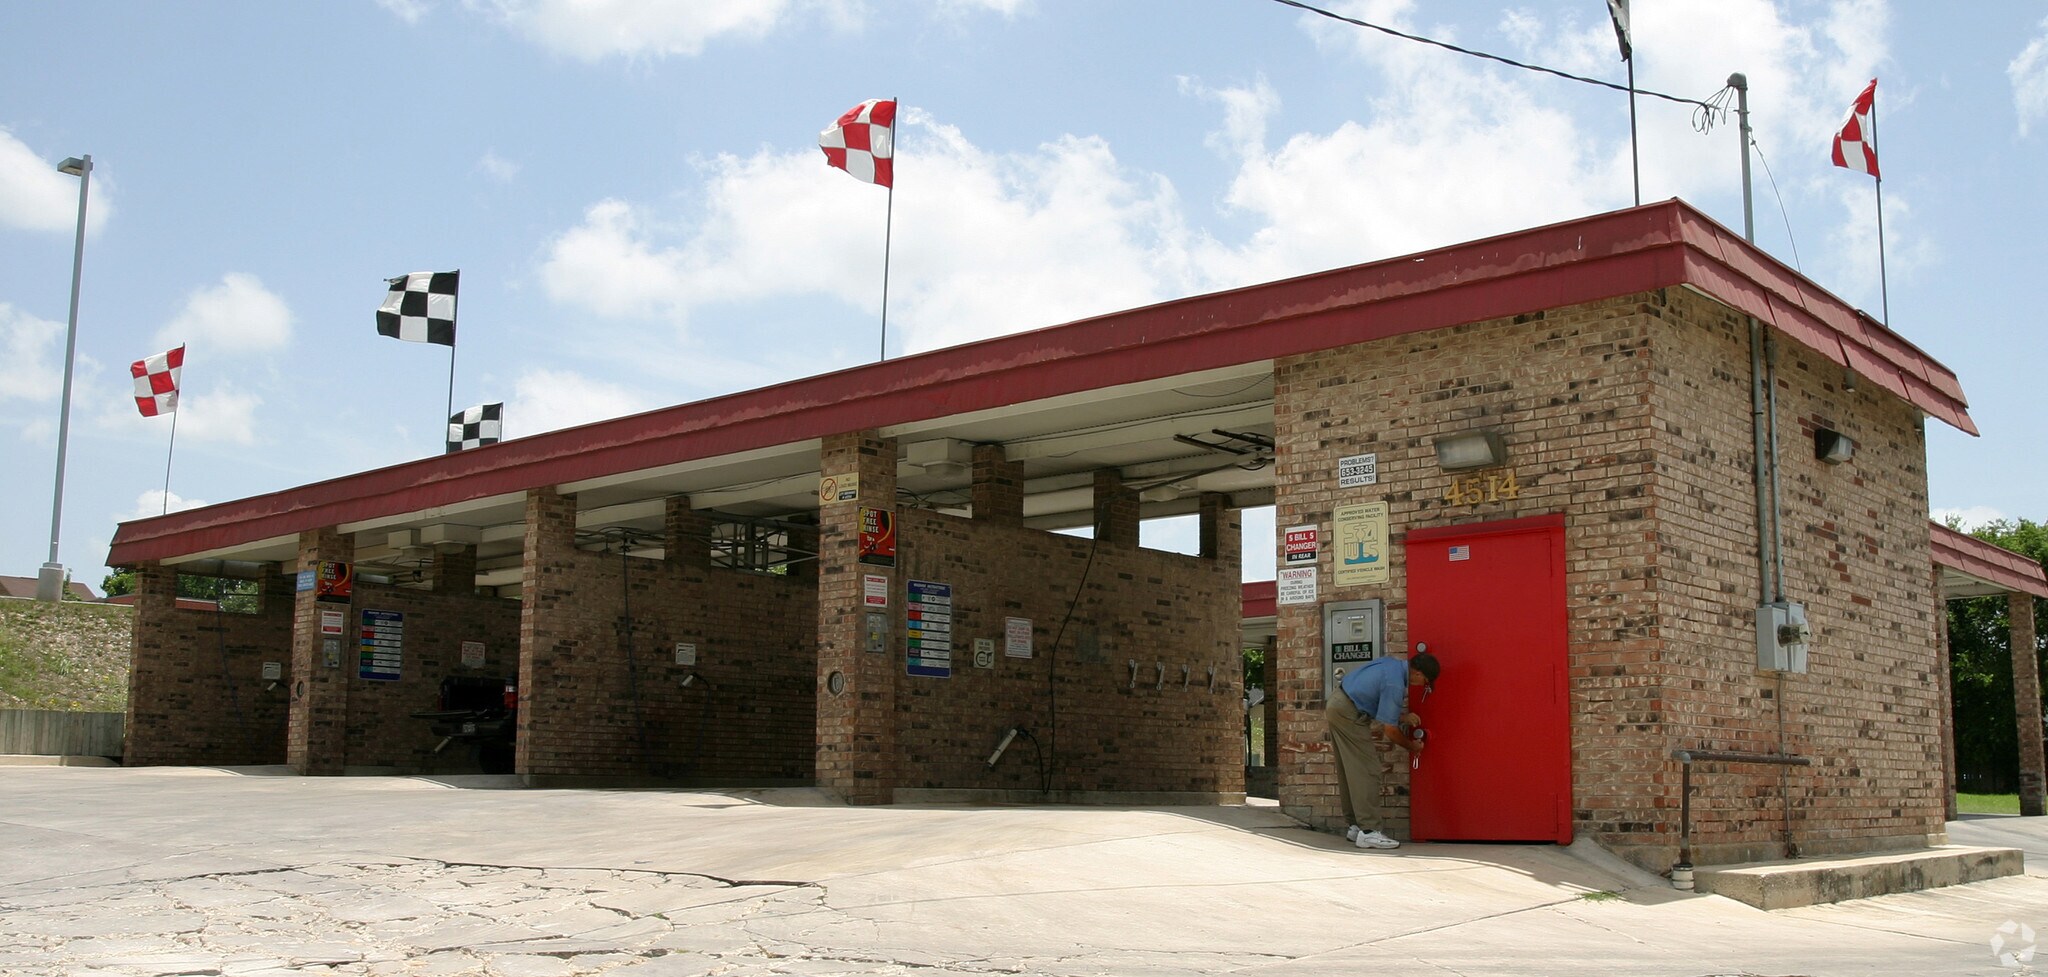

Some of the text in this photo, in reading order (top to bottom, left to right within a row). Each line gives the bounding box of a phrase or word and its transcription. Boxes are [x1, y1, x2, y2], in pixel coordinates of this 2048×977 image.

[1341, 456, 1374, 467] PROBLEMS?
[1341, 465, 1374, 477] 653-3245
[1341, 476, 1375, 485] RESULTS!
[1444, 474, 1520, 506] 4514
[1294, 532, 1308, 541] BILL
[1286, 541, 1316, 552] CHANGER
[1343, 644, 1361, 652] BILL
[1333, 651, 1371, 660] CHANGER
